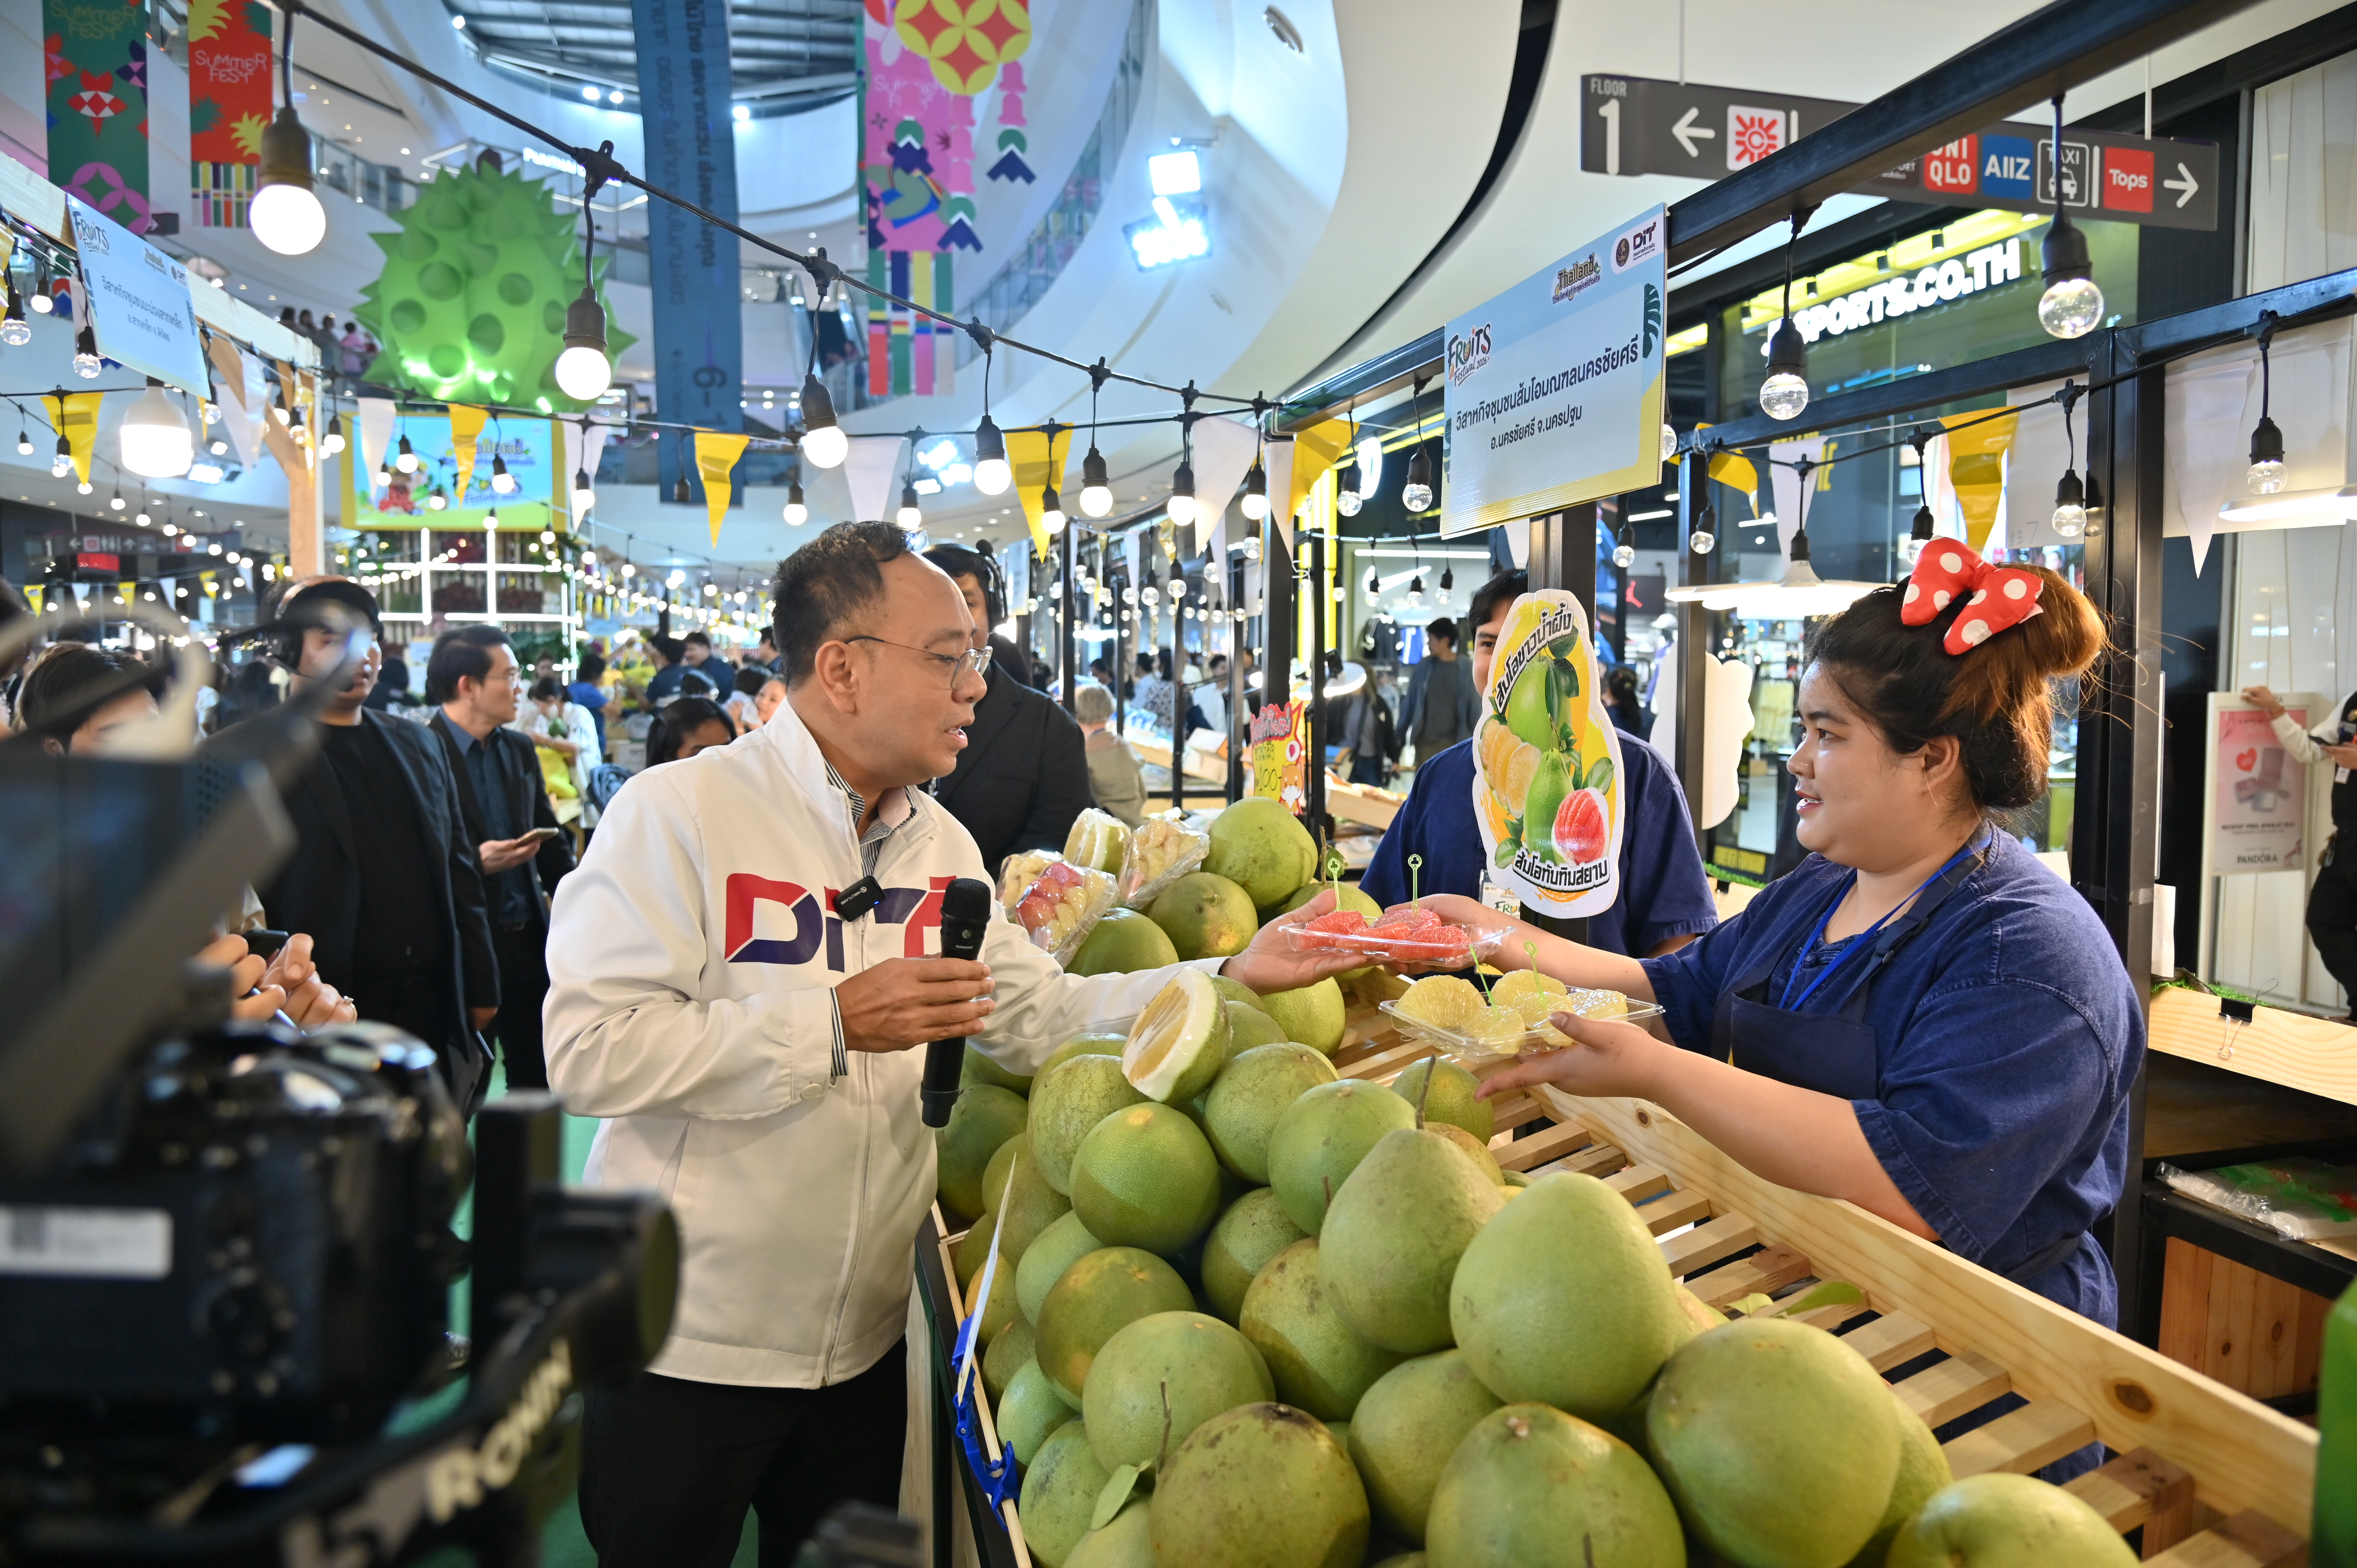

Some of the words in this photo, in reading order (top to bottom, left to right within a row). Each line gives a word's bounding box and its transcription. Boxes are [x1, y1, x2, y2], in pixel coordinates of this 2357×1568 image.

[1591, 78, 1626, 97] FLOOR
[1599, 99, 1620, 176] 1
[1931, 138, 1968, 159] NI
[1930, 160, 1971, 187] QLO
[2109, 168, 2148, 191] Tops
[1557, 253, 1595, 291] Thailand
[1559, 290, 1569, 300] land
[1573, 281, 1588, 293] tropical
[1588, 274, 1601, 287] fruits
[1454, 356, 1476, 387] Festival
[1476, 357, 1487, 370] 2026
[1456, 334, 1639, 431] วิสาหกิจชุมชนส้มโอมณฑลนครชัยศรี
[1491, 416, 1535, 450] อ.นครชัยศรี
[1537, 404, 1583, 435] จ.นครปฐม
[1514, 851, 1608, 886] ส้มโอทับทิมสยาม
[841, 891, 861, 905] HOLLYLAND
